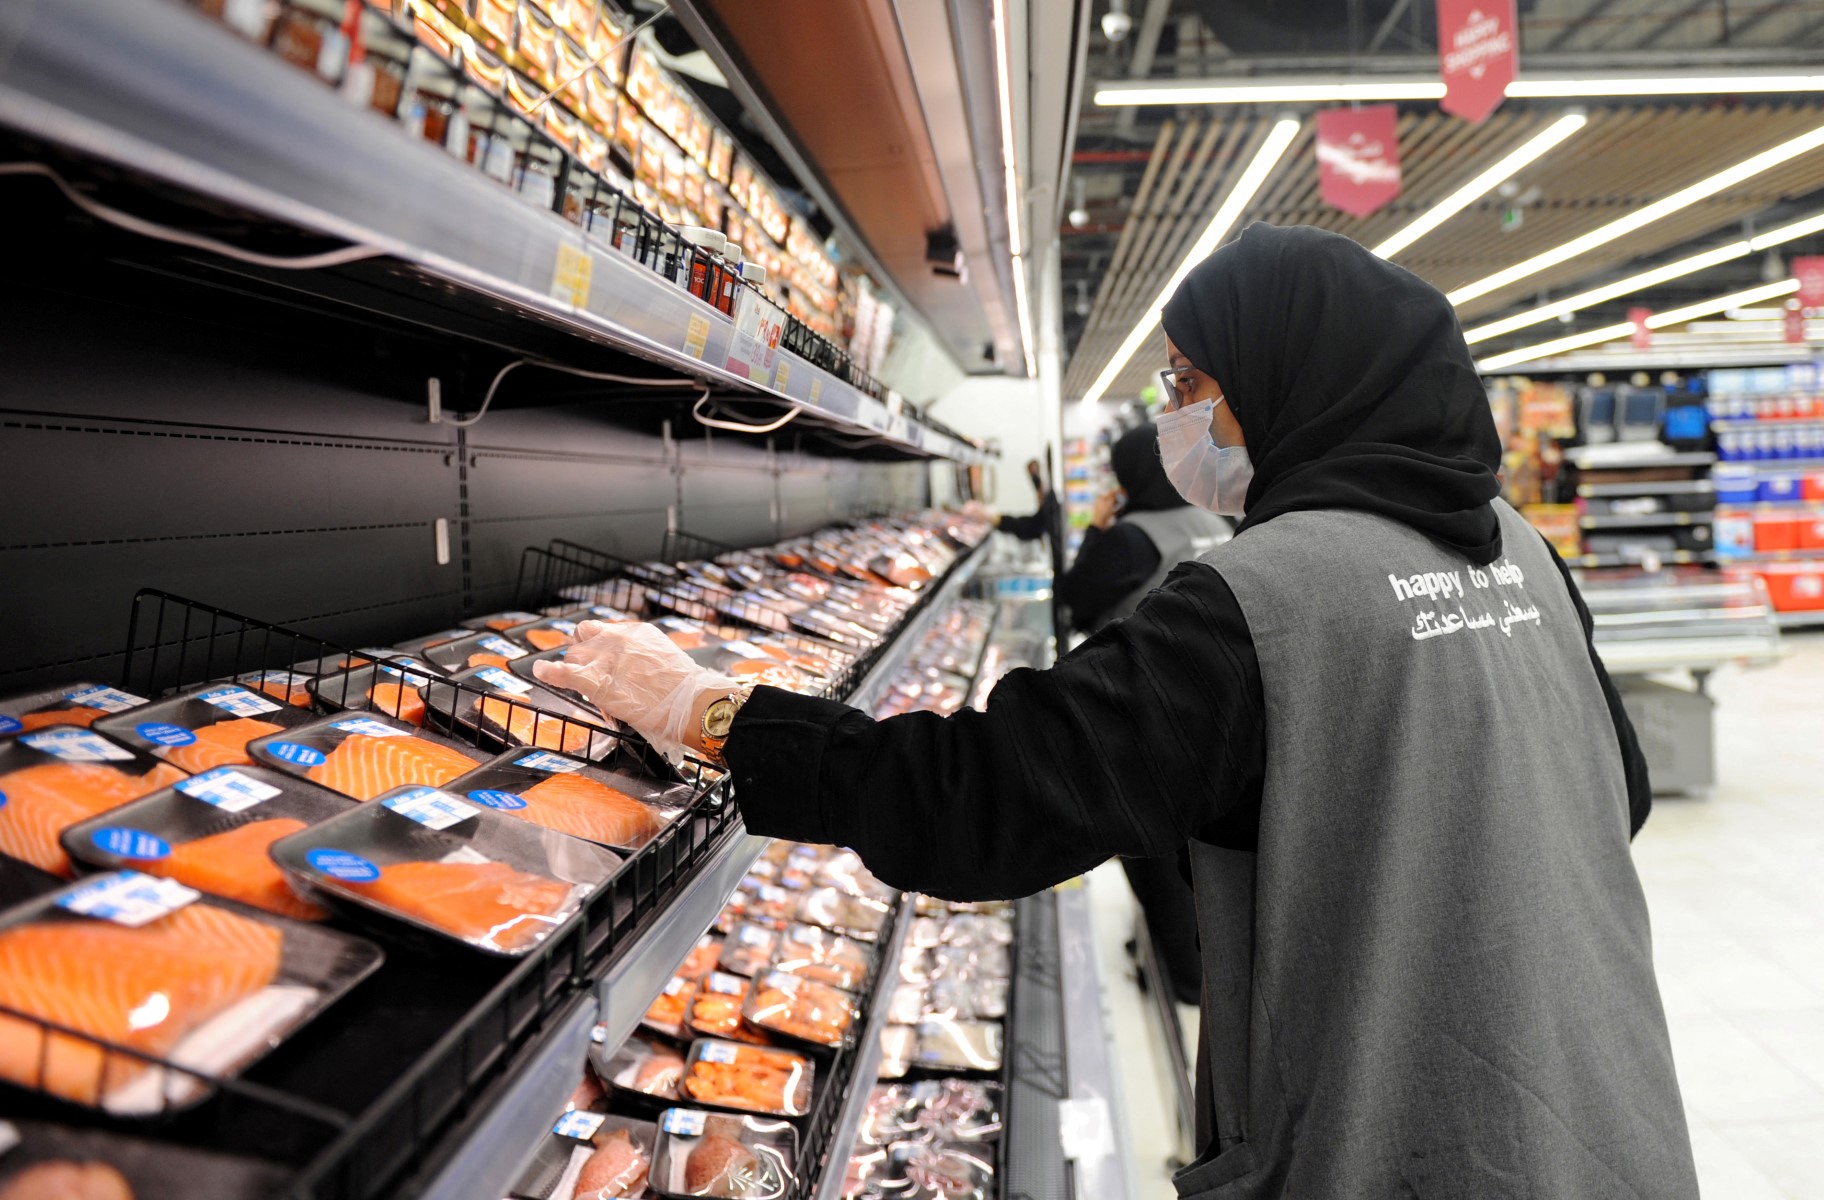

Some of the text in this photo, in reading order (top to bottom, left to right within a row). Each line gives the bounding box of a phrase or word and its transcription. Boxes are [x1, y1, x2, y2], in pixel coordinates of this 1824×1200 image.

[1388, 558, 1524, 602] happy to help
[1411, 605, 1496, 641] مساعدتك
